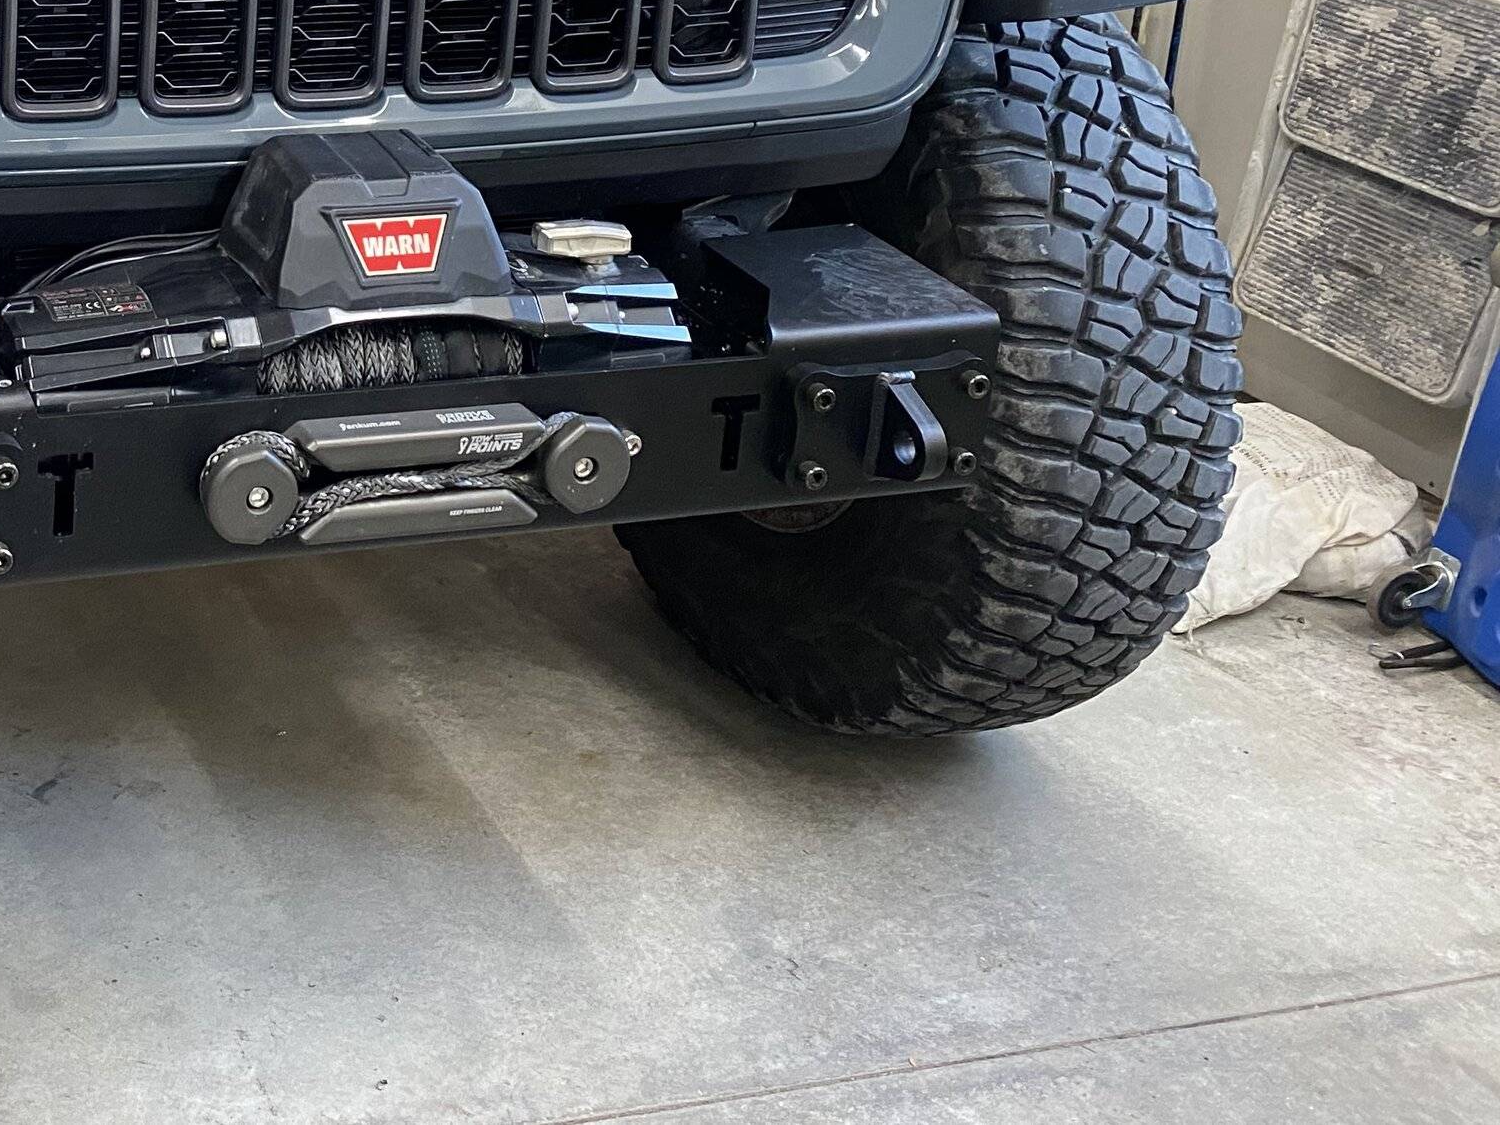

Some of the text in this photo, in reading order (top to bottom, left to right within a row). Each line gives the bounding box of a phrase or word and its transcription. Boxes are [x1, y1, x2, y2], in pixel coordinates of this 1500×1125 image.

[362, 232, 431, 258] WARN
[471, 434, 494, 443] TOW
[466, 439, 524, 455] POINTS
